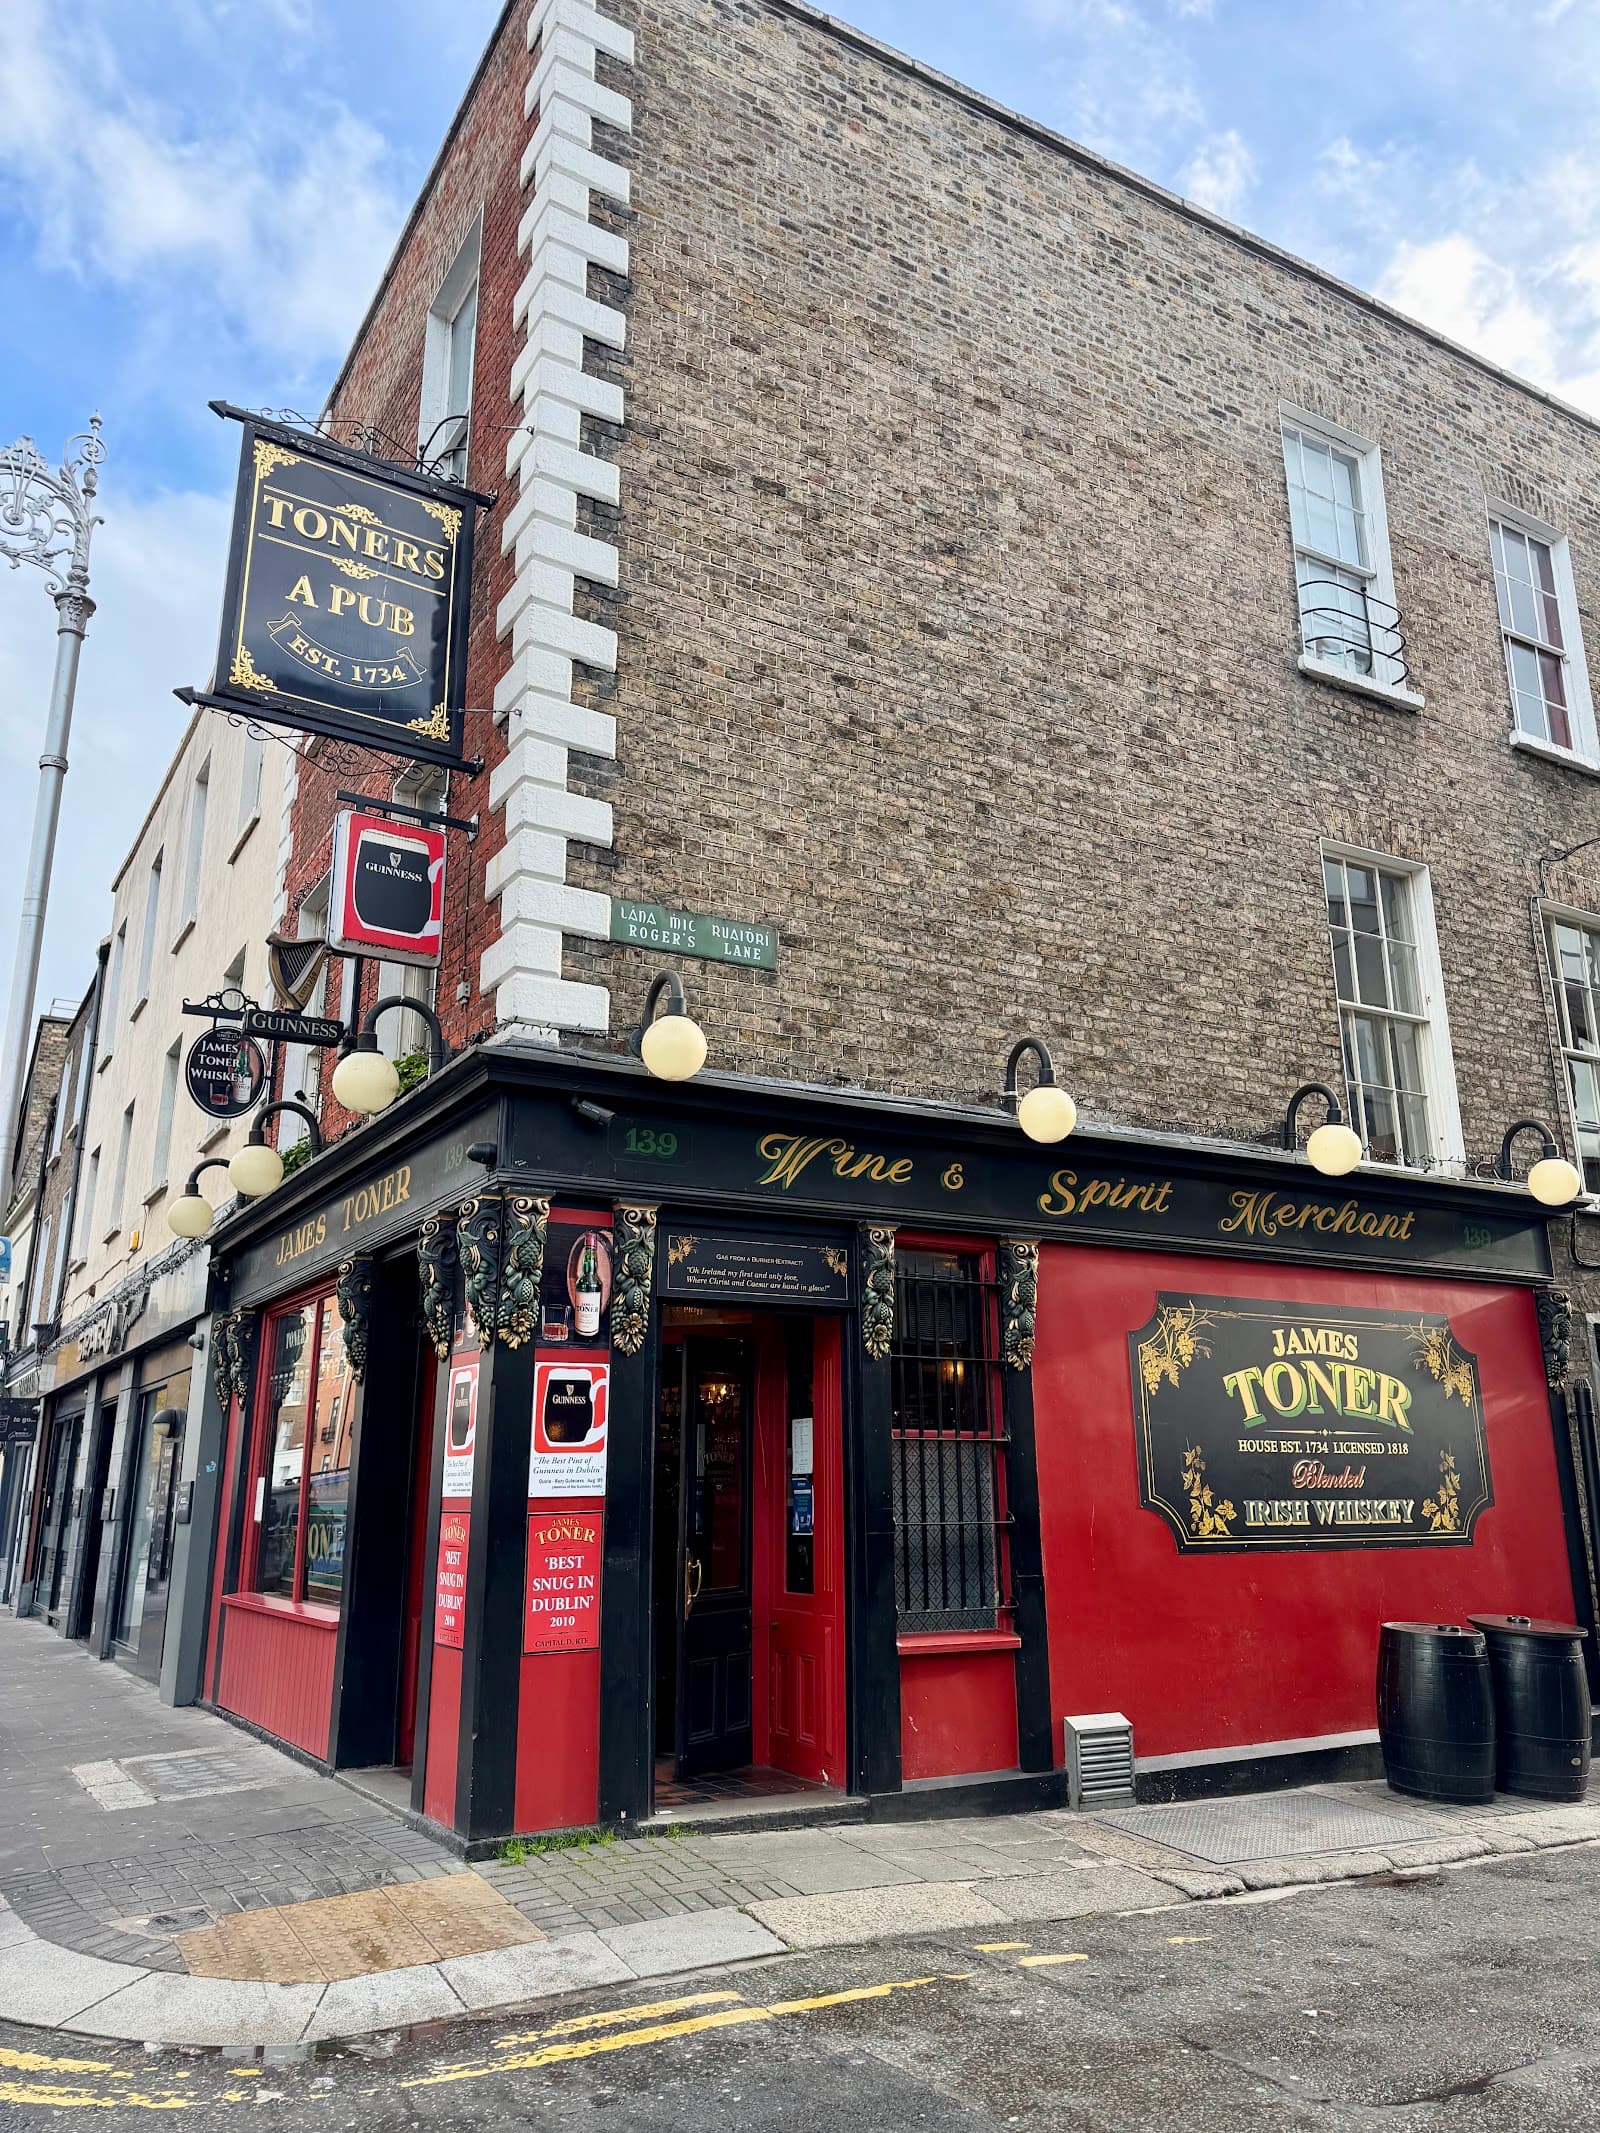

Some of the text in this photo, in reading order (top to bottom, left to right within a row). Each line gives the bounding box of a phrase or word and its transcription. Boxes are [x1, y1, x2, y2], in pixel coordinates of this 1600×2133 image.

[263, 494, 446, 581] TONERS
[285, 575, 415, 637] A PUB
[286, 634, 408, 686] EST. 1734
[364, 860, 424, 884] GUINNESS
[629, 924, 762, 961] ROGER'S LANE
[251, 1012, 339, 1039] GUINNESS
[201, 1040, 239, 1054] JAMES
[197, 1054, 240, 1068] TONER
[190, 1067, 247, 1084] WHISKEY
[625, 1128, 678, 1158] 139
[756, 1132, 964, 1191] Wine &
[1038, 1169, 1416, 1242] Spirit Merchant
[275, 1165, 411, 1266] JAMES TONER
[686, 1275, 709, 1285] Where
[709, 1276, 731, 1286] Christ
[731, 1278, 745, 1287] and
[781, 1281, 800, 1291] hand
[800, 1283, 807, 1291] in
[701, 1266, 726, 1276] Ireland
[727, 1270, 738, 1279] my
[738, 1269, 754, 1280] first
[754, 1271, 768, 1280] and
[768, 1272, 784, 1282] only
[1272, 1327, 1359, 1361] JAMES
[552, 1394, 586, 1405] GUINNESS
[1222, 1359, 1415, 1435] TONER
[1238, 1439, 1409, 1455] HOUSE EST. 1734 LICENSED 1818
[533, 1466, 565, 1475] Guinness
[551, 1456, 566, 1465] Best
[567, 1456, 583, 1464] Pint
[584, 1456, 594, 1466] of
[1292, 1459, 1366, 1490] Blended
[1243, 1499, 1415, 1526] IRISH WHISKEY
[551, 1517, 581, 1528] JAMES
[535, 1526, 597, 1546] TONER
[456, 1573, 465, 1588] IN
[532, 1574, 595, 1593] SNUG IN
[531, 1595, 595, 1613] DUBLIN'
[549, 1615, 576, 1628] 2010
[534, 1638, 566, 1649] CAPITAL
